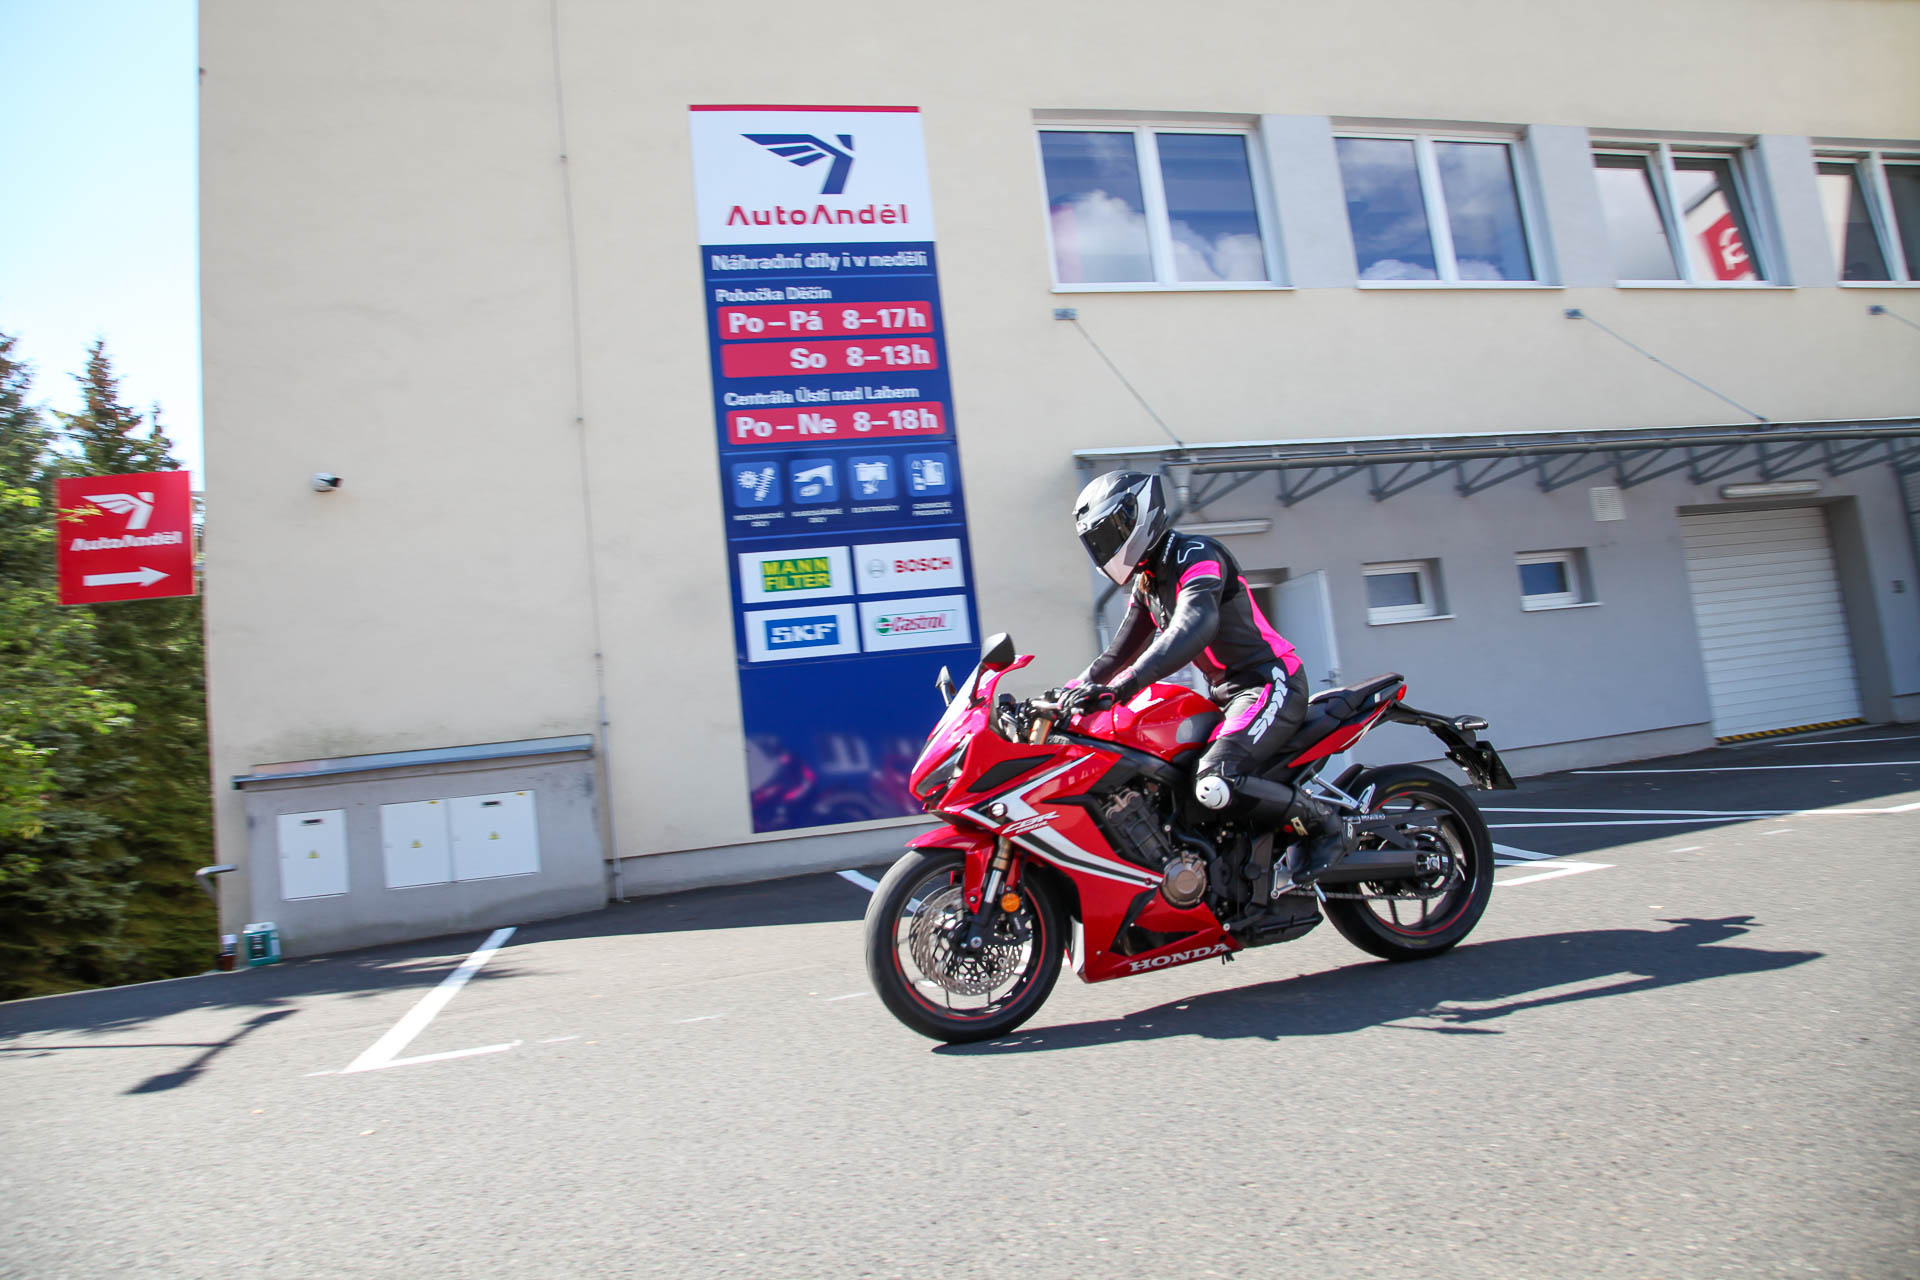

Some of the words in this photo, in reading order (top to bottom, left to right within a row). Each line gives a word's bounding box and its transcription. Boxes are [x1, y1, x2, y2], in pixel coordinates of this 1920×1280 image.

[728, 312, 765, 334] Po
[788, 310, 824, 332] Pá
[789, 347, 828, 369] So
[735, 416, 773, 438] Po
[797, 413, 838, 435] Ne
[763, 558, 828, 575] MANN
[893, 557, 953, 574] BOSCH
[765, 573, 832, 590] FILTER
[770, 622, 837, 644] SKF
[1129, 943, 1232, 972] HONDA
